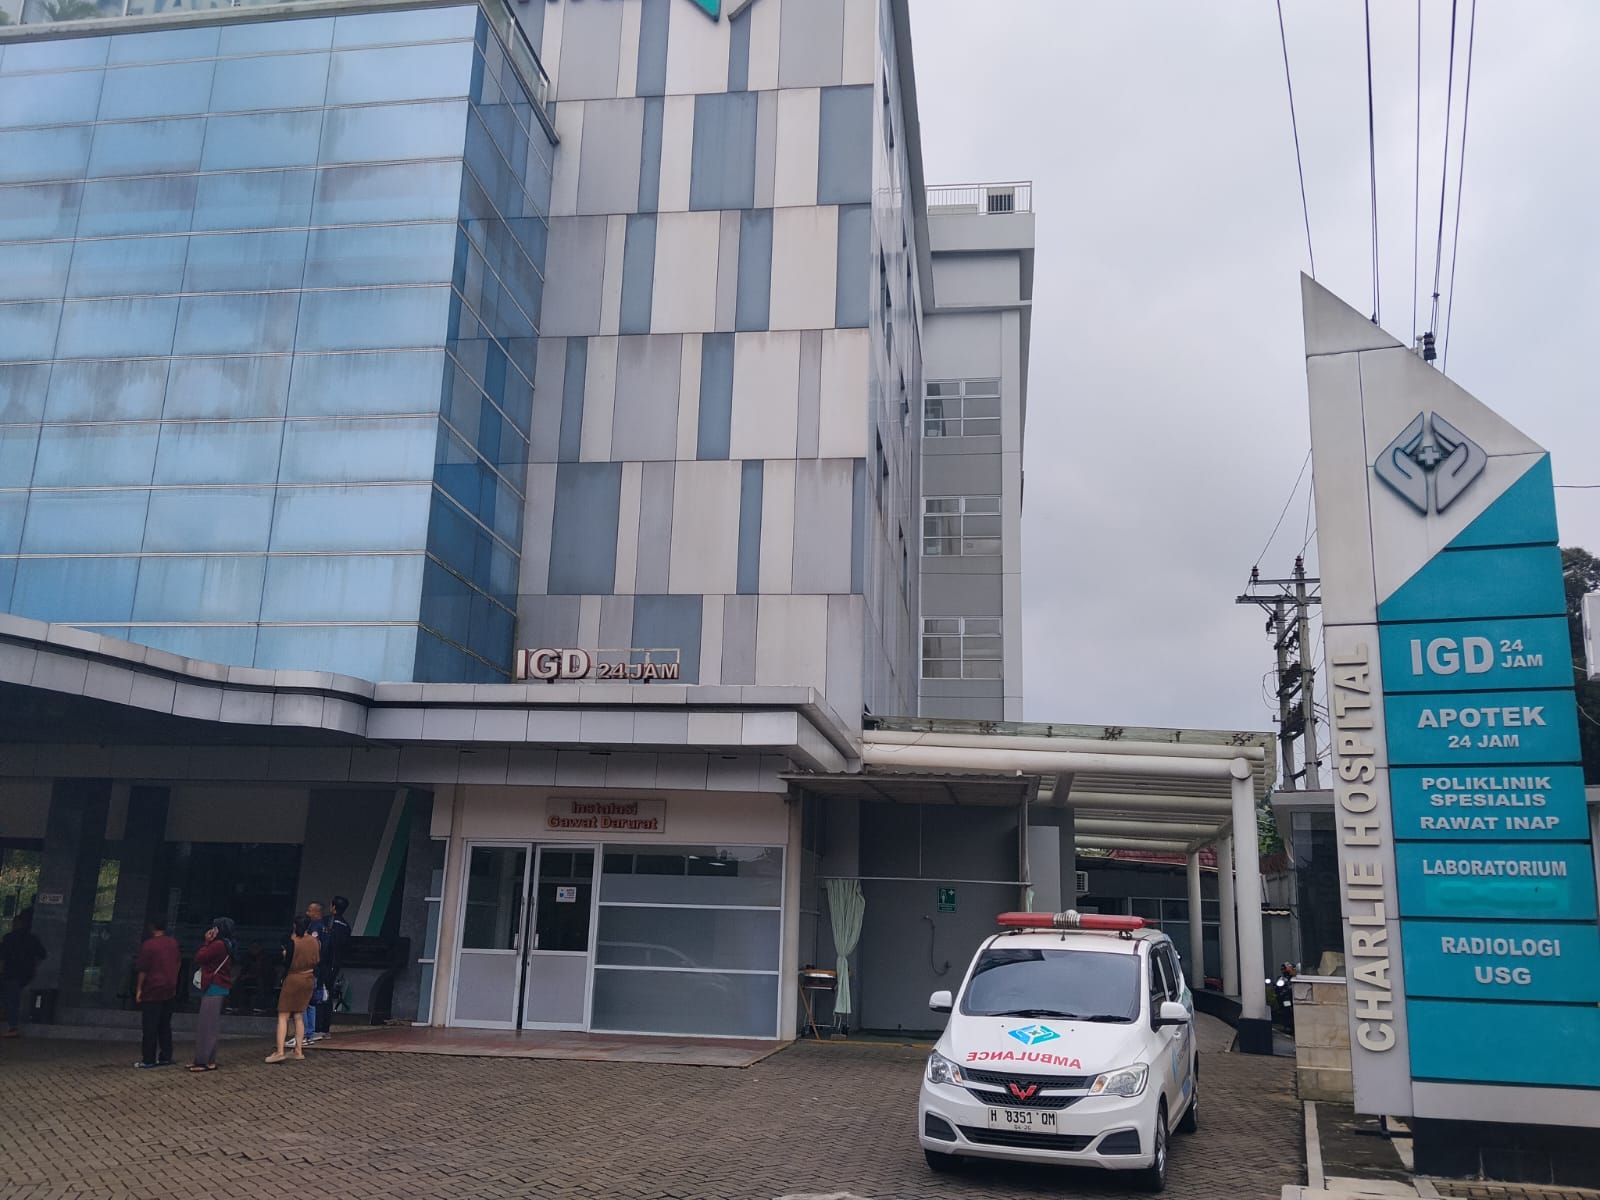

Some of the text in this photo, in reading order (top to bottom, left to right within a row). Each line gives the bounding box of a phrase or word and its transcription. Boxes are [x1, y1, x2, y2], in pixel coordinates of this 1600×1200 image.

[1500, 639, 1524, 653] 24
[1410, 636, 1495, 676] IGD
[1501, 653, 1544, 669] JAM
[516, 648, 679, 680] IGD 24 JAM
[1417, 706, 1547, 729] APOTEK
[1447, 734, 1520, 749] 24 JAM
[1421, 776, 1552, 791] POLIKLINIK
[1430, 793, 1546, 807] SPESIALIS
[573, 802, 638, 816] Instalasi
[547, 815, 658, 830] Gawat Darurat
[1420, 816, 1560, 831] RAWAT INAP
[1333, 645, 1396, 1052] CHARLIE HOSPITAL
[1422, 859, 1567, 877] LABORATORIUM
[1441, 936, 1561, 957] RADIOLOGI
[1474, 966, 1532, 986] USG
[990, 1109, 997, 1122] H
[1006, 1111, 1033, 1124] 8351
